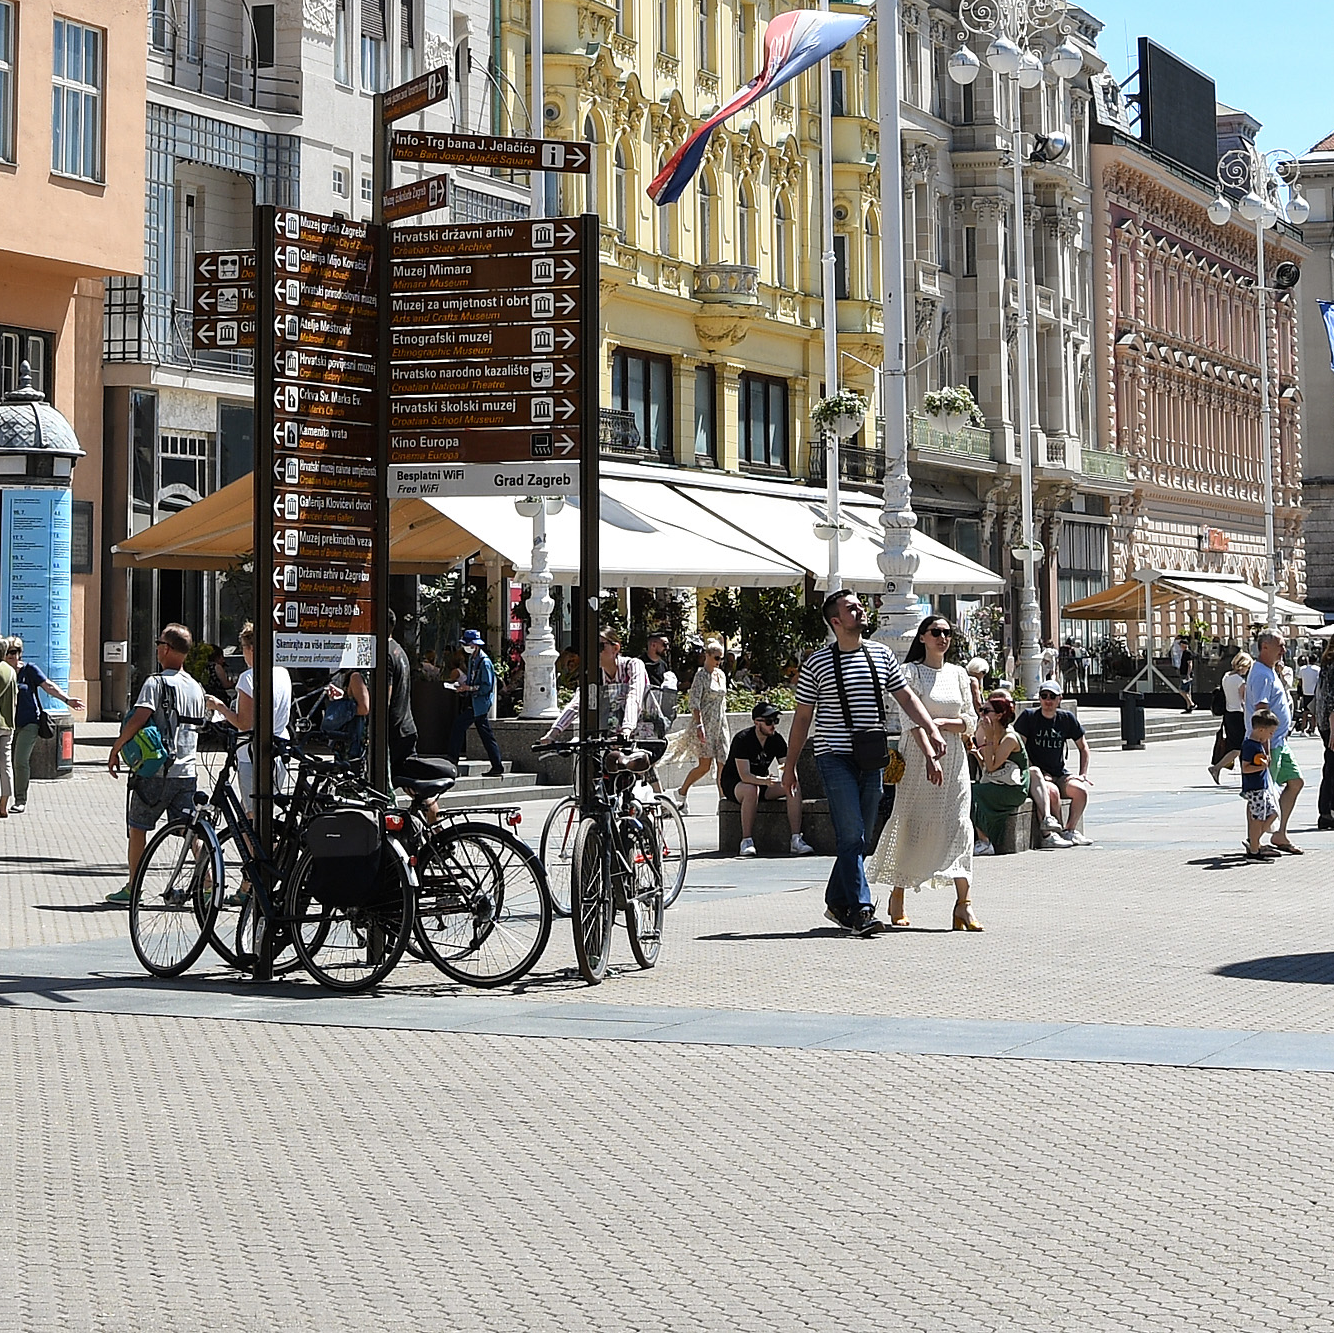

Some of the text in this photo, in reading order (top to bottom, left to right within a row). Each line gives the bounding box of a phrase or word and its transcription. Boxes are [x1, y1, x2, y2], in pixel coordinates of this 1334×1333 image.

[396, 135, 536, 154] Info Trg bana J. Jelačića
[395, 150, 533, 166] Info Ban Josip Jelačić Square
[300, 216, 367, 239] Muzej grada Zagreba
[393, 227, 514, 243] Hrvatski državni arhiv
[300, 249, 326, 264] Galerija
[393, 243, 492, 256] Croatian State Archive
[393, 264, 472, 278] Muzej Mimara
[393, 279, 469, 289] Mimara Museum
[392, 295, 530, 313] Muzej za umjetnost i obrt
[392, 312, 500, 324] Arts and Crafts Museum
[300, 318, 352, 335] Atelje Meštrović
[392, 330, 492, 348] Etnografski muzej
[392, 346, 493, 359] Ethnographic Museum
[300, 353, 376, 375] Hrvatski povijesni muzej
[392, 364, 529, 379] Hrvatsko narodno kazalište
[392, 380, 505, 392] Croatian National Theatre
[300, 388, 319, 400] Crkva
[331, 392, 351, 404] Marka
[352, 394, 362, 405] Ev.
[392, 399, 516, 414] Hrvatski školski muzej
[392, 415, 504, 427] Croatian School Museum
[299, 424, 348, 439] Kamenita vrata
[392, 436, 459, 450] Kino Europa
[392, 451, 459, 460] Cinema Europa
[397, 469, 465, 483] Besplatni WiFi
[494, 473, 571, 489] Grad Zagreb
[397, 484, 439, 494] Free WiFi
[300, 495, 324, 508] Galerija
[356, 500, 371, 510] dvori
[300, 531, 372, 547] Muzej prekinutih veza
[299, 567, 322, 579] Državni
[323, 568, 338, 580] arhiv
[300, 602, 319, 616] Muzej
[320, 603, 342, 617] Zagreb
[304, 641, 311, 649] za
[275, 654, 289, 662] Scan
[1037, 730, 1061, 738] JACK
[1035, 739, 1062, 748] WILLS
